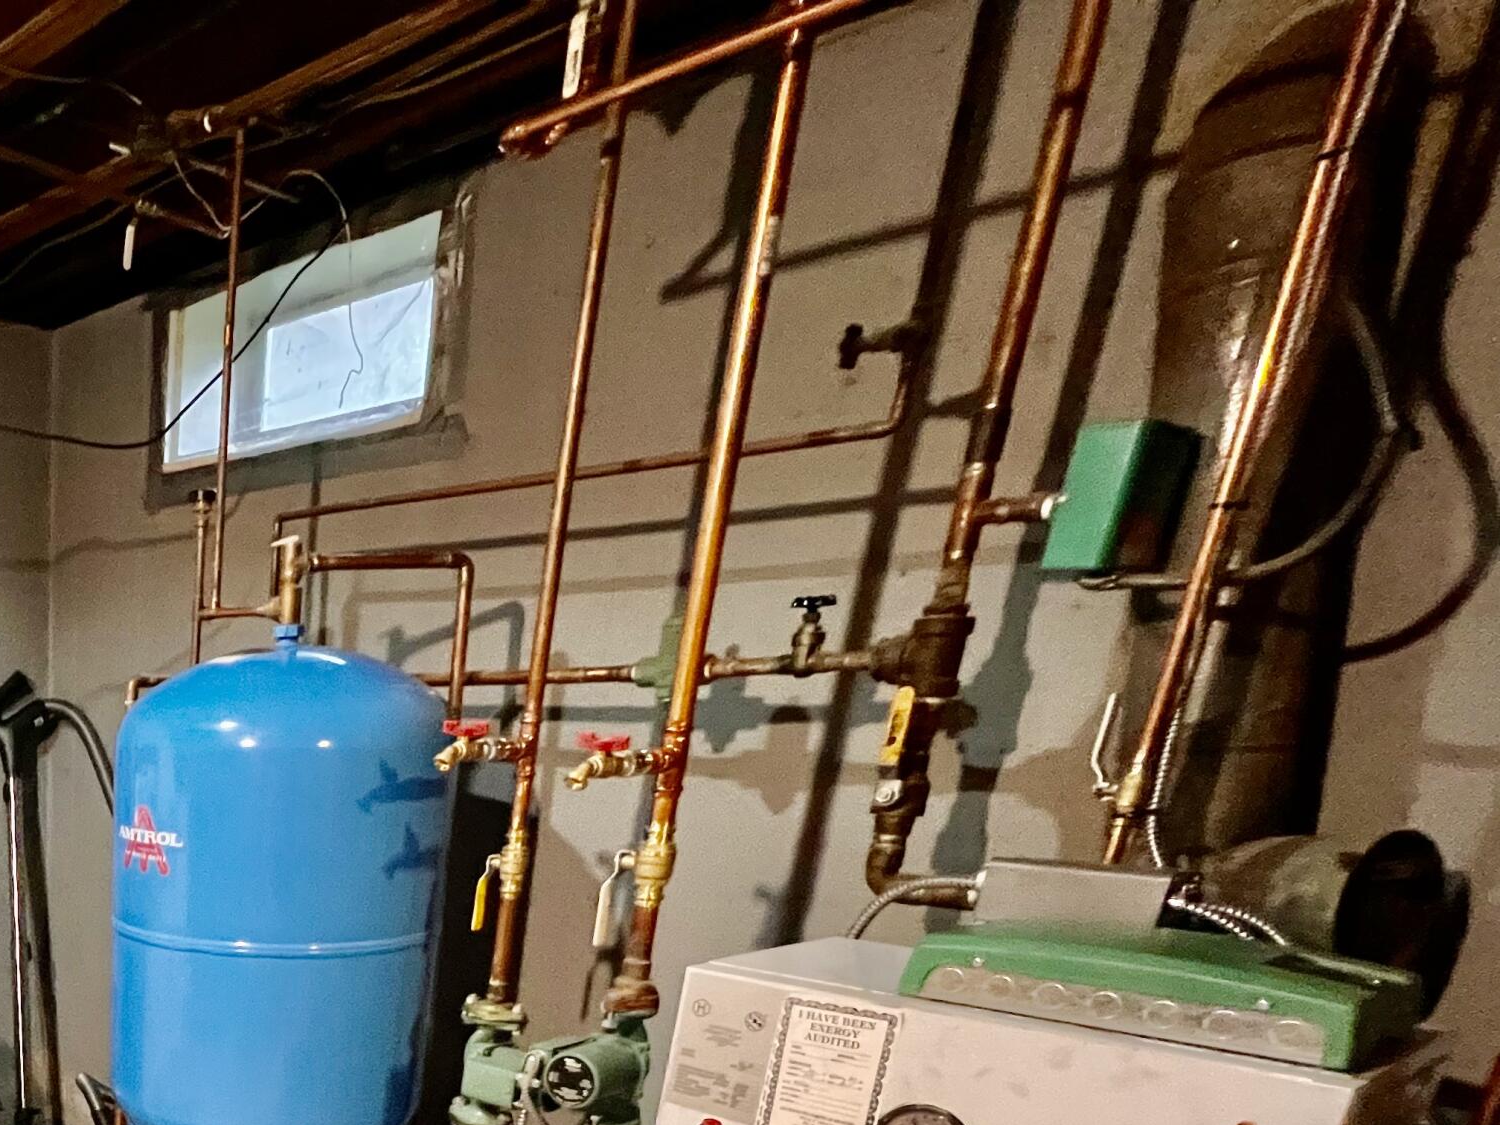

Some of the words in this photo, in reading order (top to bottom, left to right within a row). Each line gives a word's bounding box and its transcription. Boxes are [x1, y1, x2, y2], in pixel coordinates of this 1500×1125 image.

[118, 825, 184, 848] AMTROL
[806, 1011, 841, 1025] HAVE
[842, 1017, 877, 1031] BEEN
[810, 1022, 861, 1039] ENERGY
[804, 1032, 861, 1050] AUDITED
